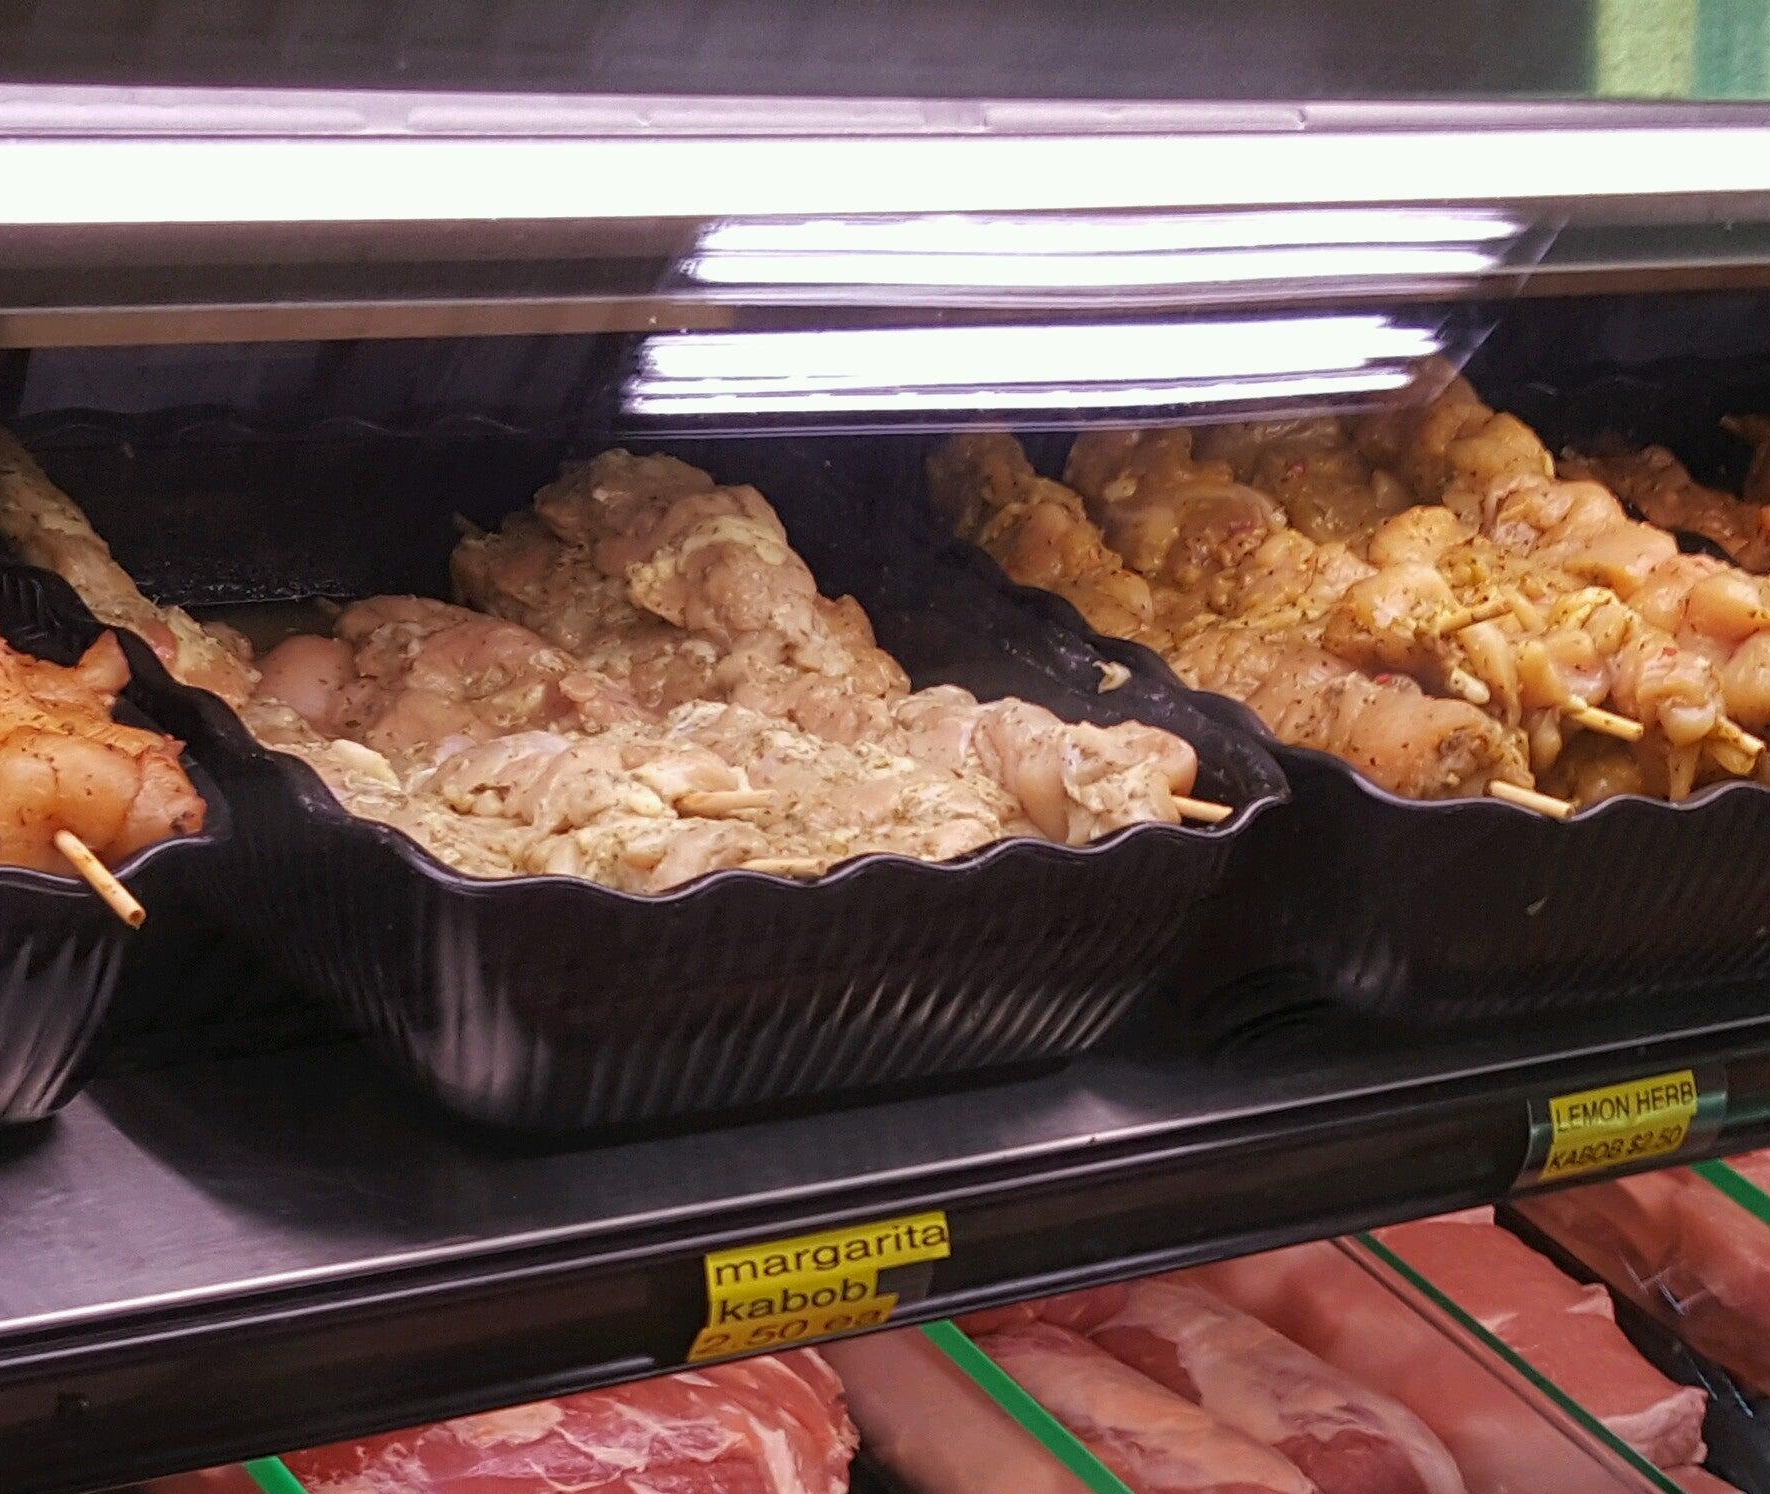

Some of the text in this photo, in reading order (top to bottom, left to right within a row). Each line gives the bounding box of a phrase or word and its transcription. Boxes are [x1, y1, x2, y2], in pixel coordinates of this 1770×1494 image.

[1555, 1081, 1693, 1131] LEMON HERB
[715, 1221, 948, 1287] margarita
[717, 1277, 868, 1325] kabob
